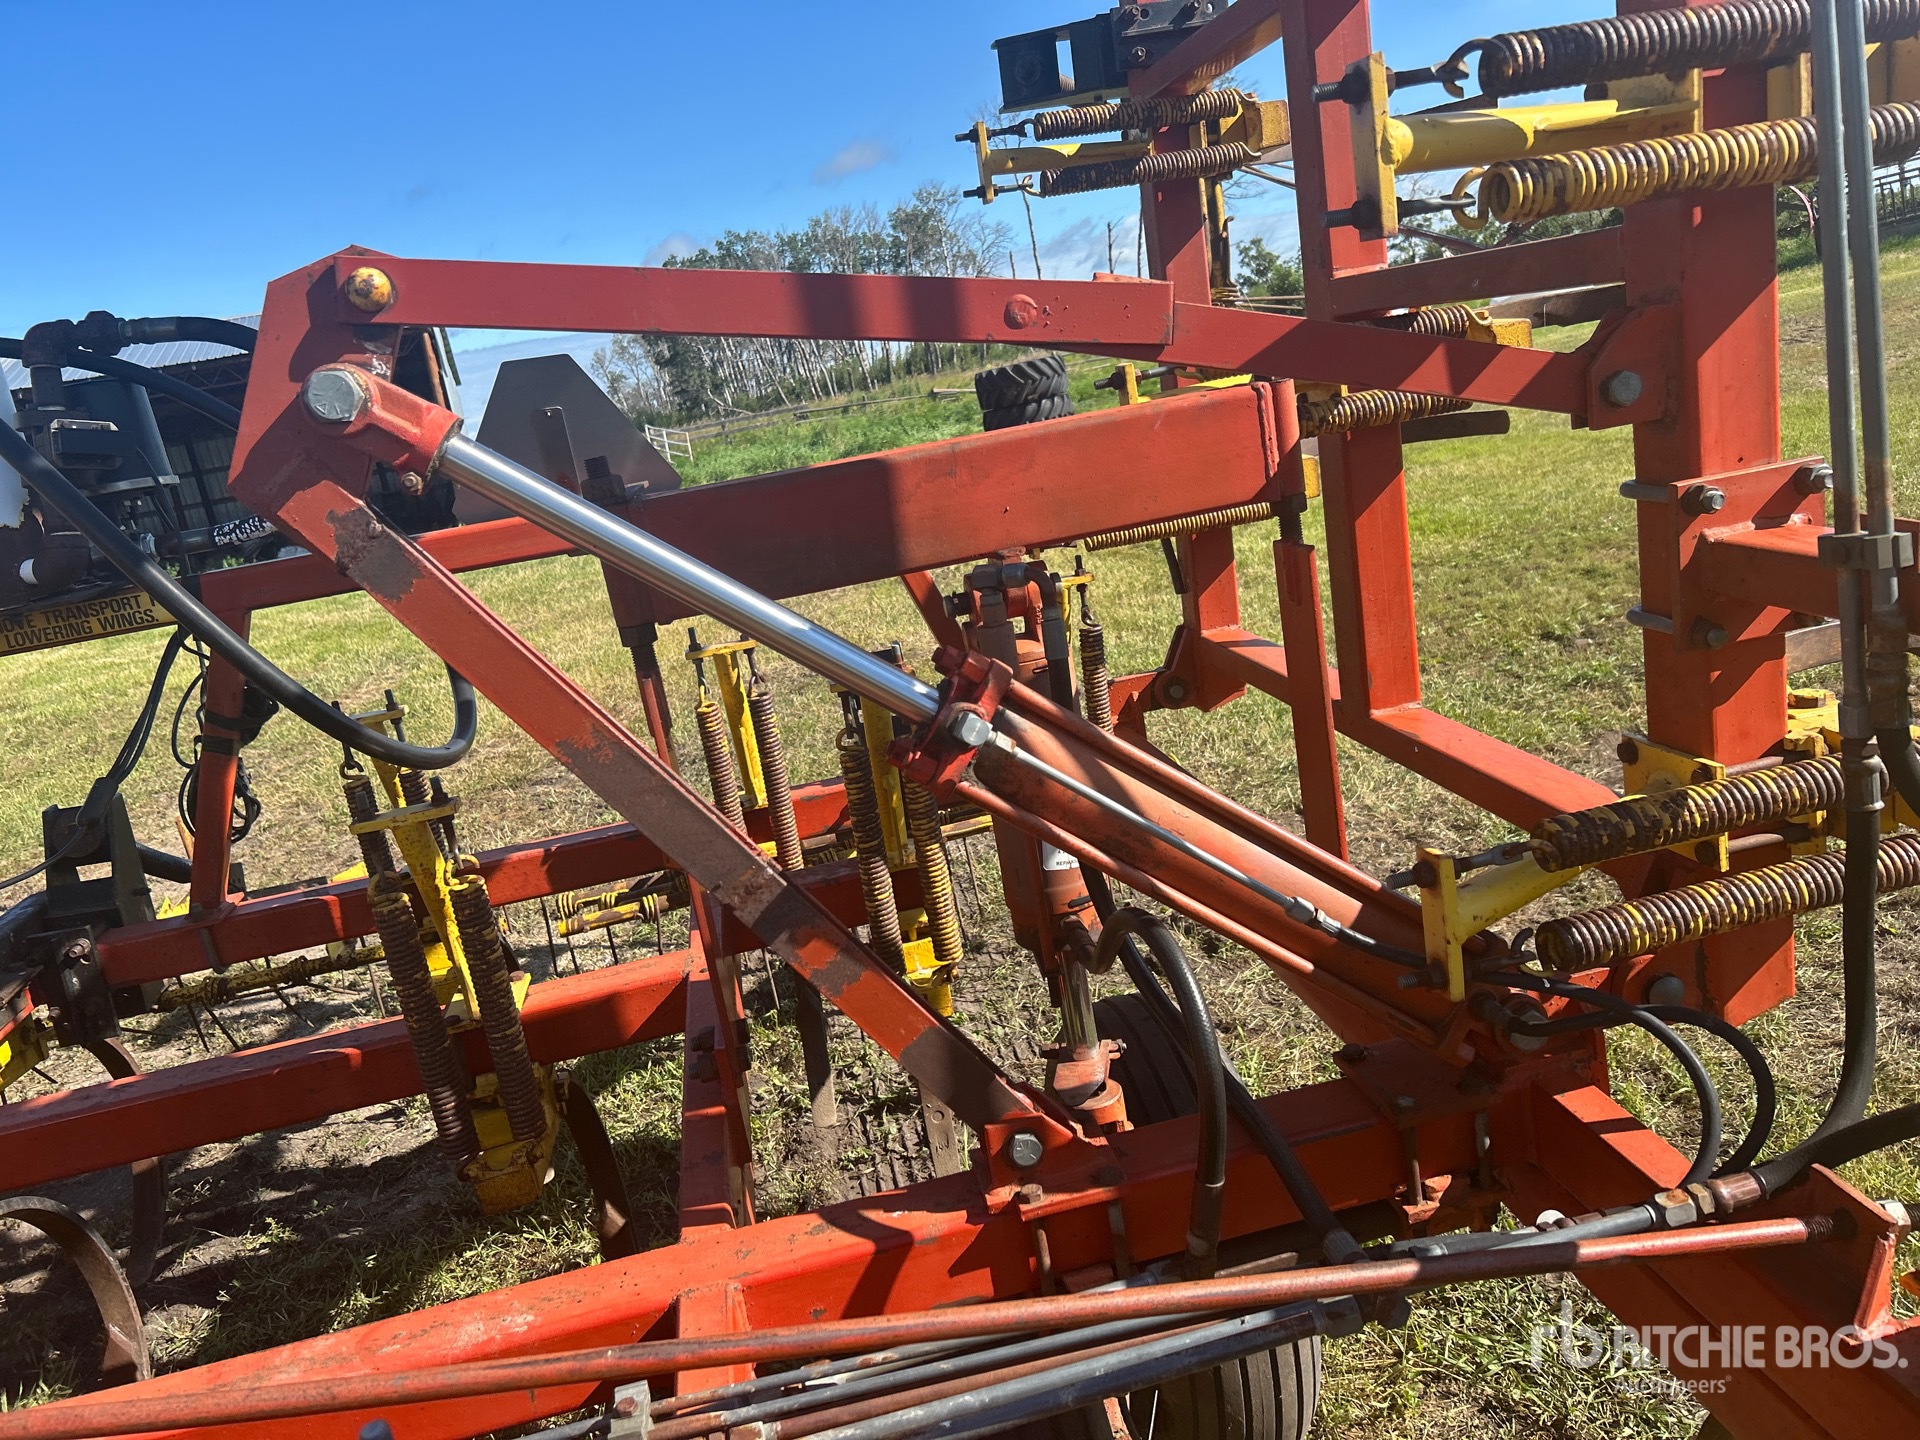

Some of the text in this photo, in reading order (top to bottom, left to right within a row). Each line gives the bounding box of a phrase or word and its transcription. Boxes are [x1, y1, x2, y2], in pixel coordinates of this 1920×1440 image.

[40, 595, 142, 624] TRANSPORT
[5, 609, 159, 649] LOWERING WINGS.
